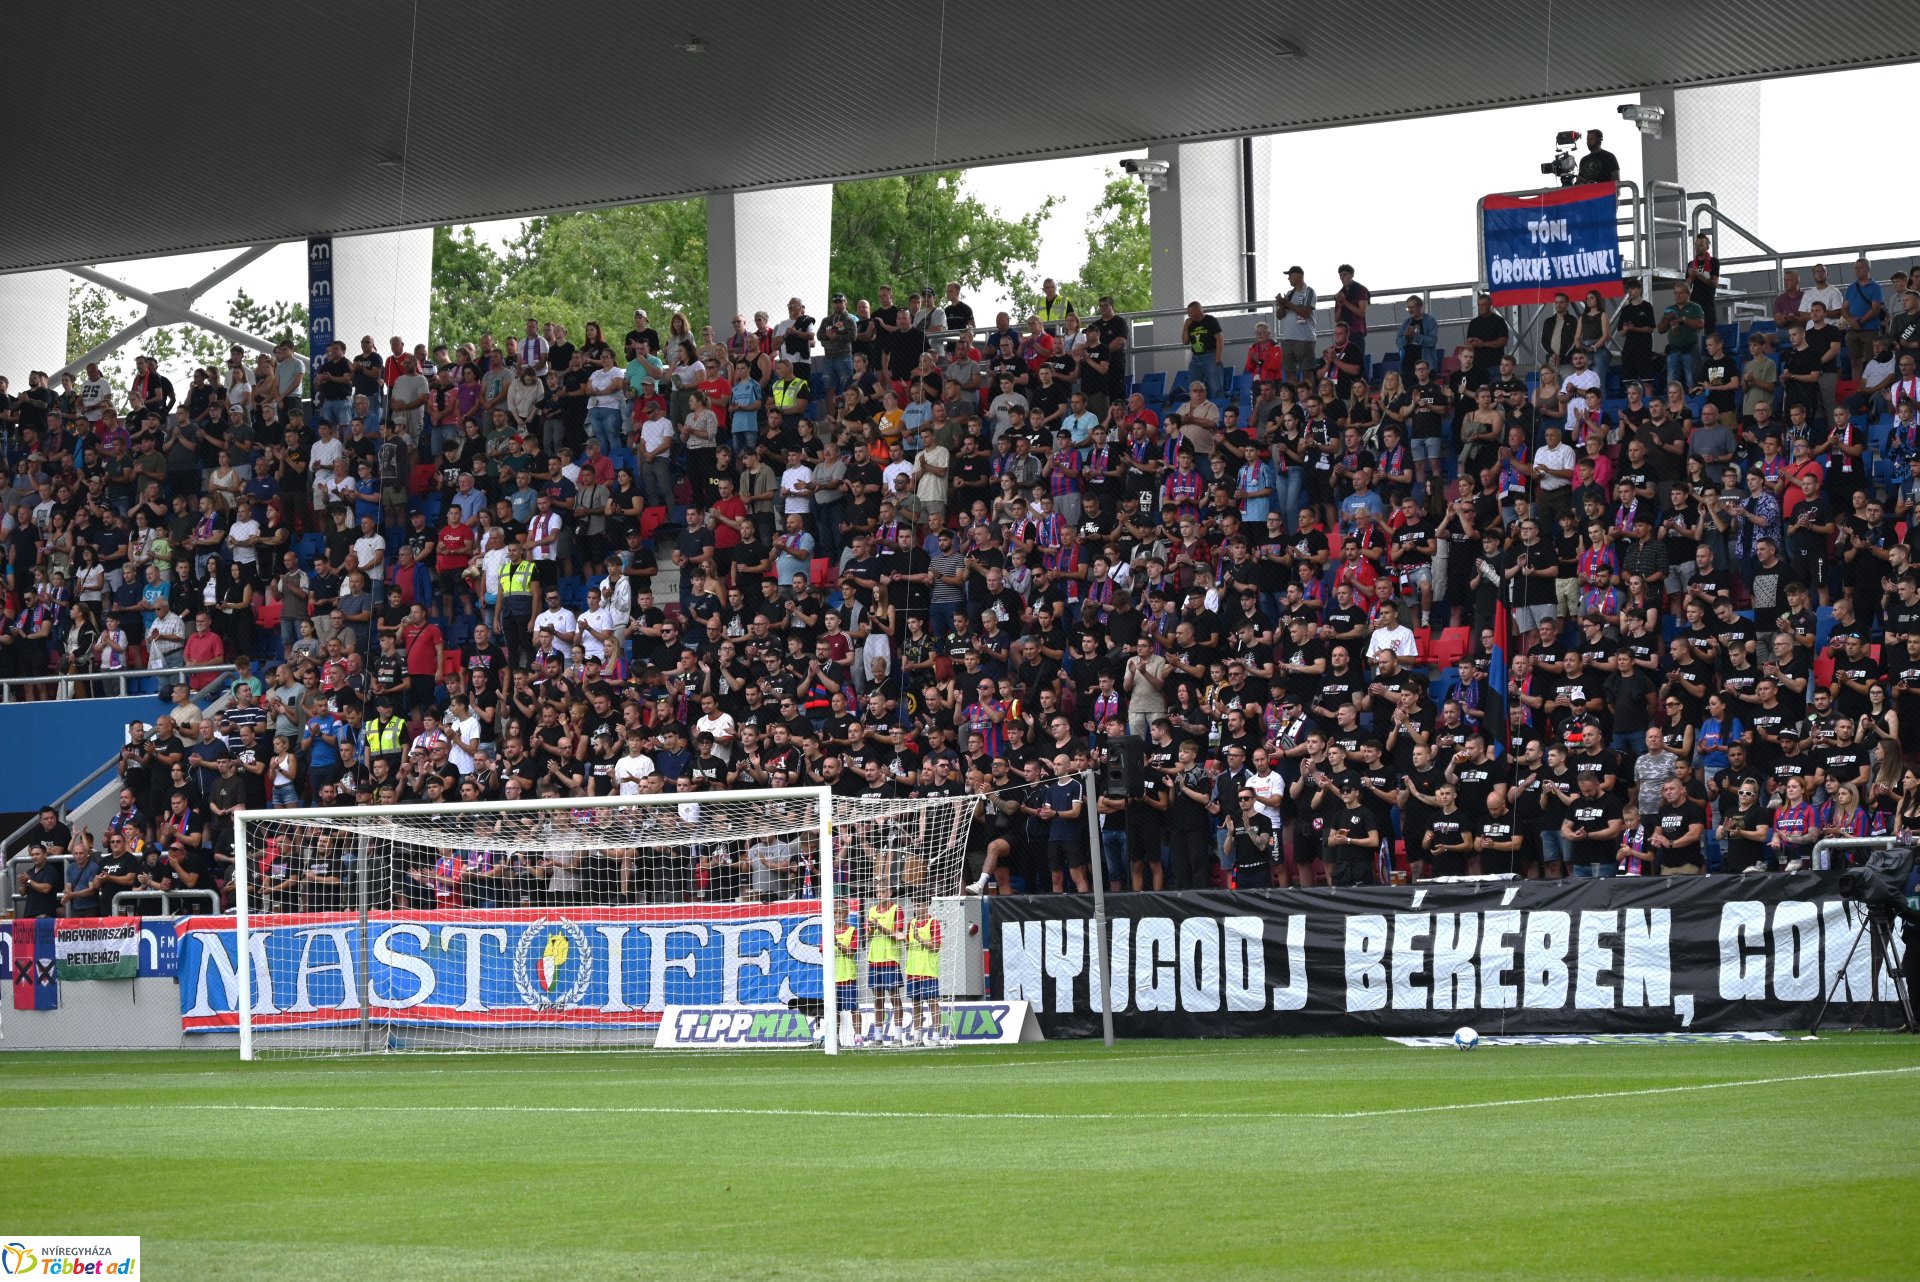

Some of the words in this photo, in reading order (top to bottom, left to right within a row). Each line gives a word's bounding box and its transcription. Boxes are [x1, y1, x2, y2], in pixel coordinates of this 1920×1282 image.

[1528, 214, 1572, 244] TÓNI,
[1491, 250, 1551, 285] ÖRÖKKÉ
[57, 924, 136, 943] MAGYARORSZÁG
[66, 948, 120, 967] PETNEHÁZA
[1001, 914, 1309, 1013] NYUGODJ
[1344, 887, 1695, 1027] BÉKÉBEN,
